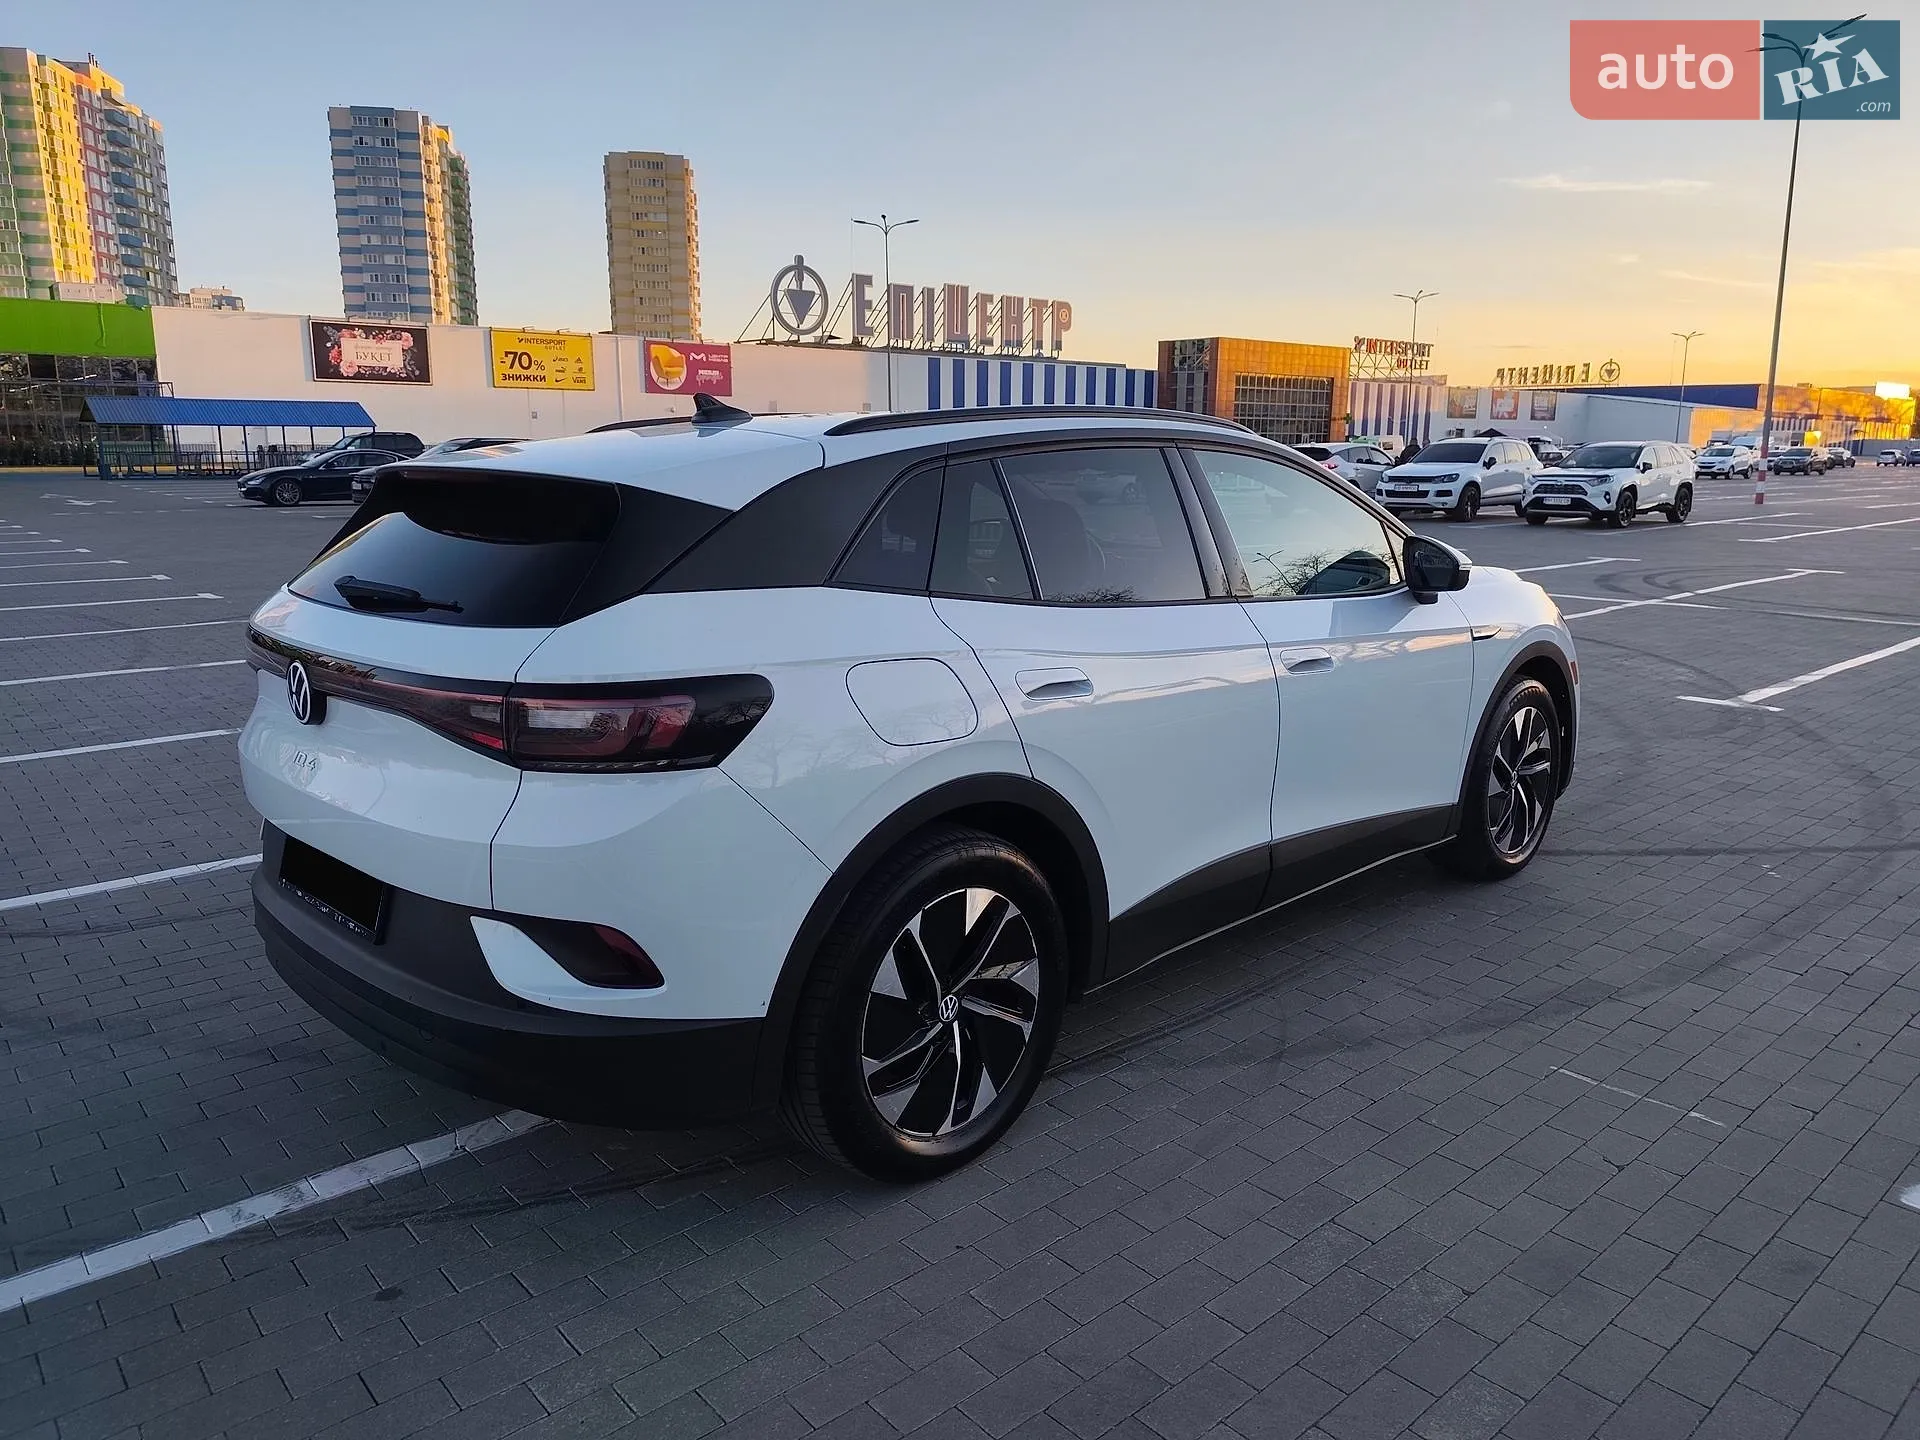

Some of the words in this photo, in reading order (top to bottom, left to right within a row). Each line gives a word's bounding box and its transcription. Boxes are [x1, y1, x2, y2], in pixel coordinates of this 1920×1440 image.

[851, 272, 1073, 351] ЕПІЦЕНТР
[525, 337, 566, 346] INTERSPORT
[1366, 337, 1434, 358] INTERSPORT
[355, 351, 393, 363] БУКЕТ
[1396, 358, 1430, 371] OUTLET
[501, 373, 547, 383] ЗНИЖКИ
